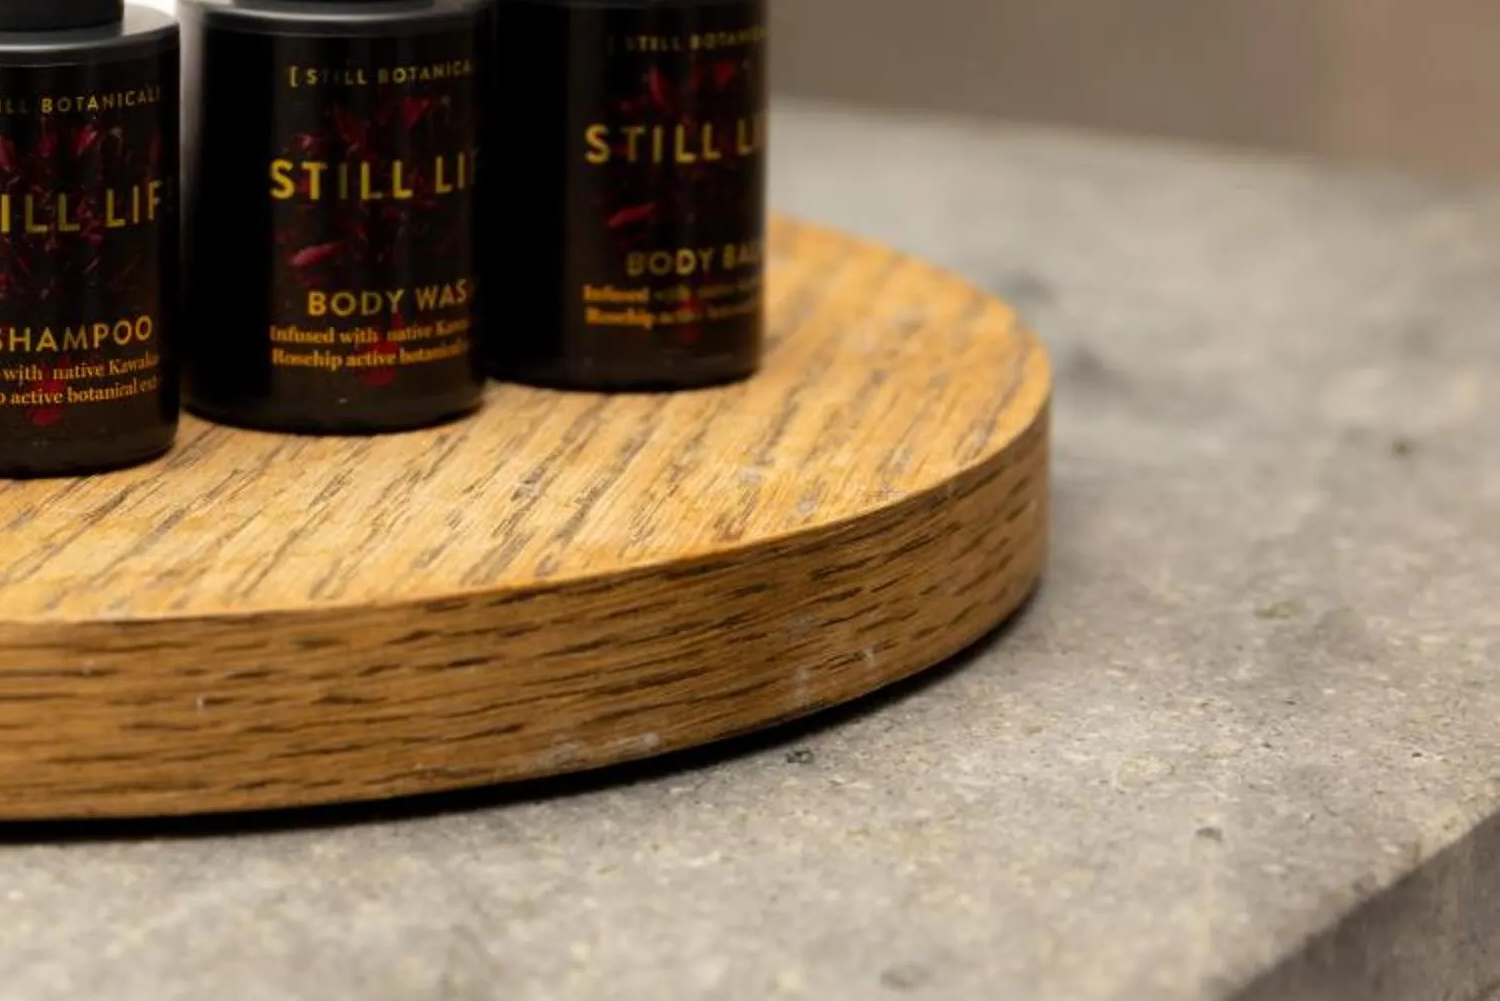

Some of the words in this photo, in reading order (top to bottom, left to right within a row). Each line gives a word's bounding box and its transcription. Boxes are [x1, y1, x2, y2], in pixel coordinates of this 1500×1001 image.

[584, 122, 721, 164] STILL
[269, 158, 414, 201] STILL
[626, 247, 713, 276] BODY
[308, 289, 405, 317] BODY
